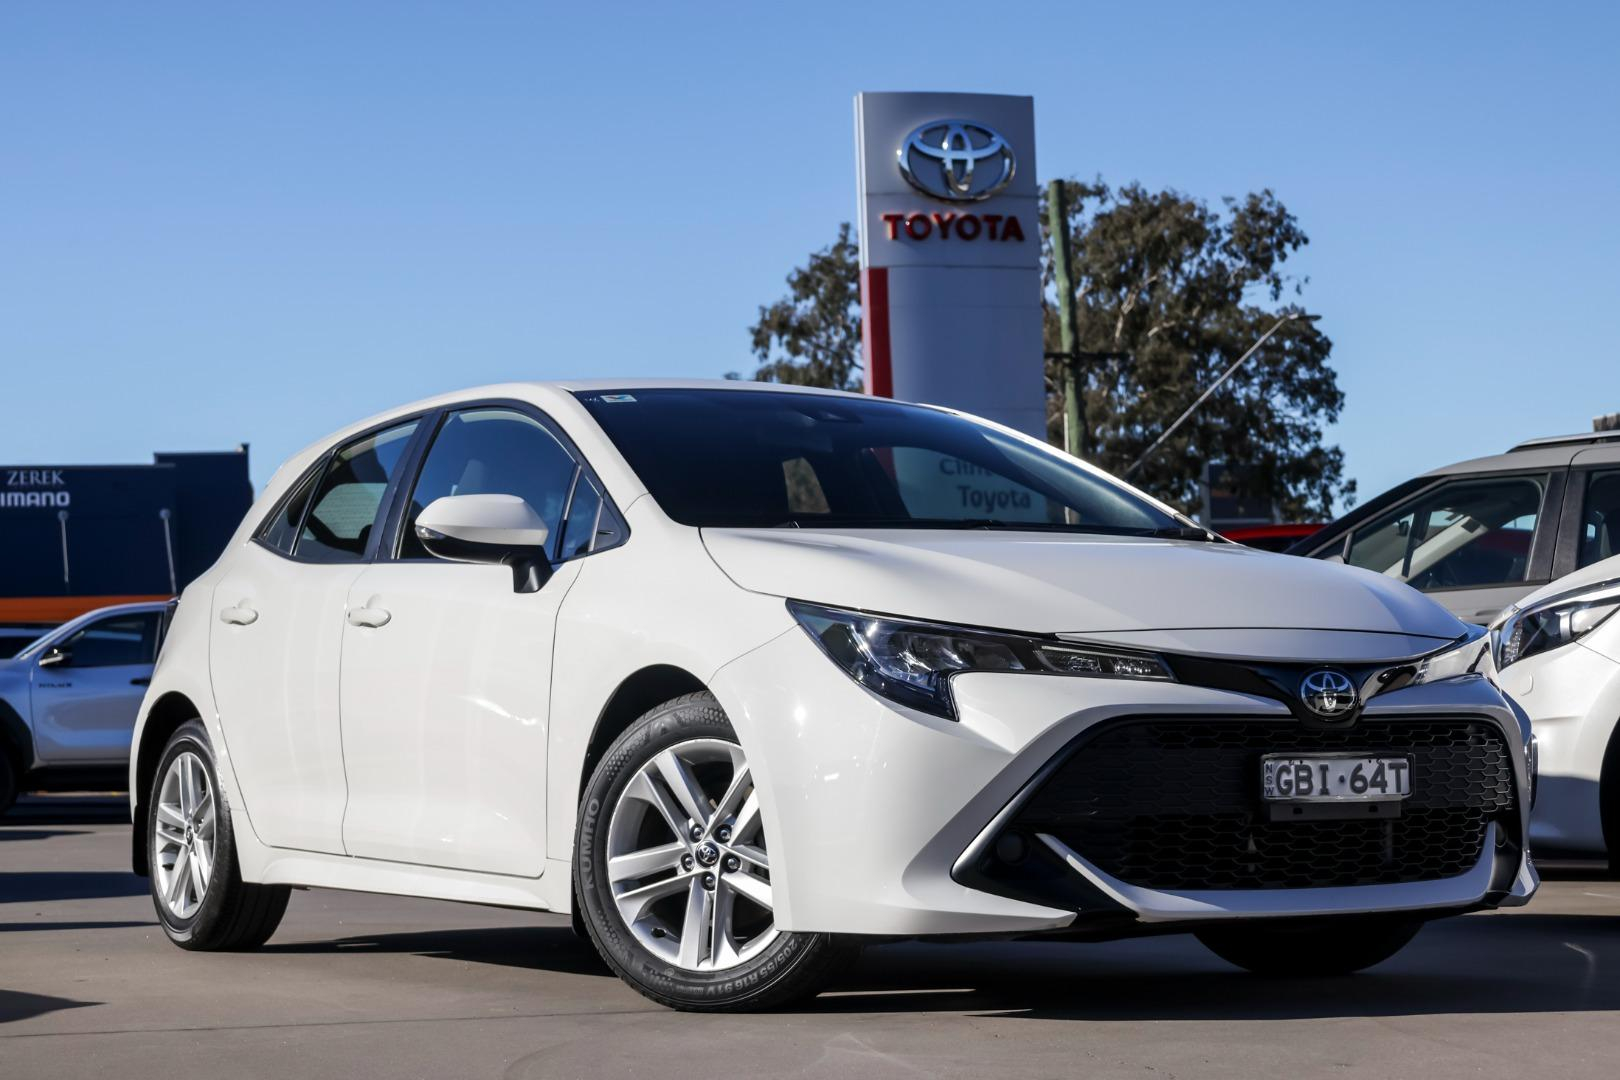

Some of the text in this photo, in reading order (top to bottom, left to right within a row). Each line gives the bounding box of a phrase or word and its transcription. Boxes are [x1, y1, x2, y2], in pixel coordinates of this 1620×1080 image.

[882, 212, 1025, 242] TOYOTA
[7, 469, 65, 486] ZEREK
[957, 485, 1031, 513] Toyota
[1264, 764, 1274, 796] NSW
[581, 798, 600, 890] KUMHO
[759, 937, 798, 978] 205/55
[706, 983, 733, 996] 91V
[734, 972, 759, 989] R16
